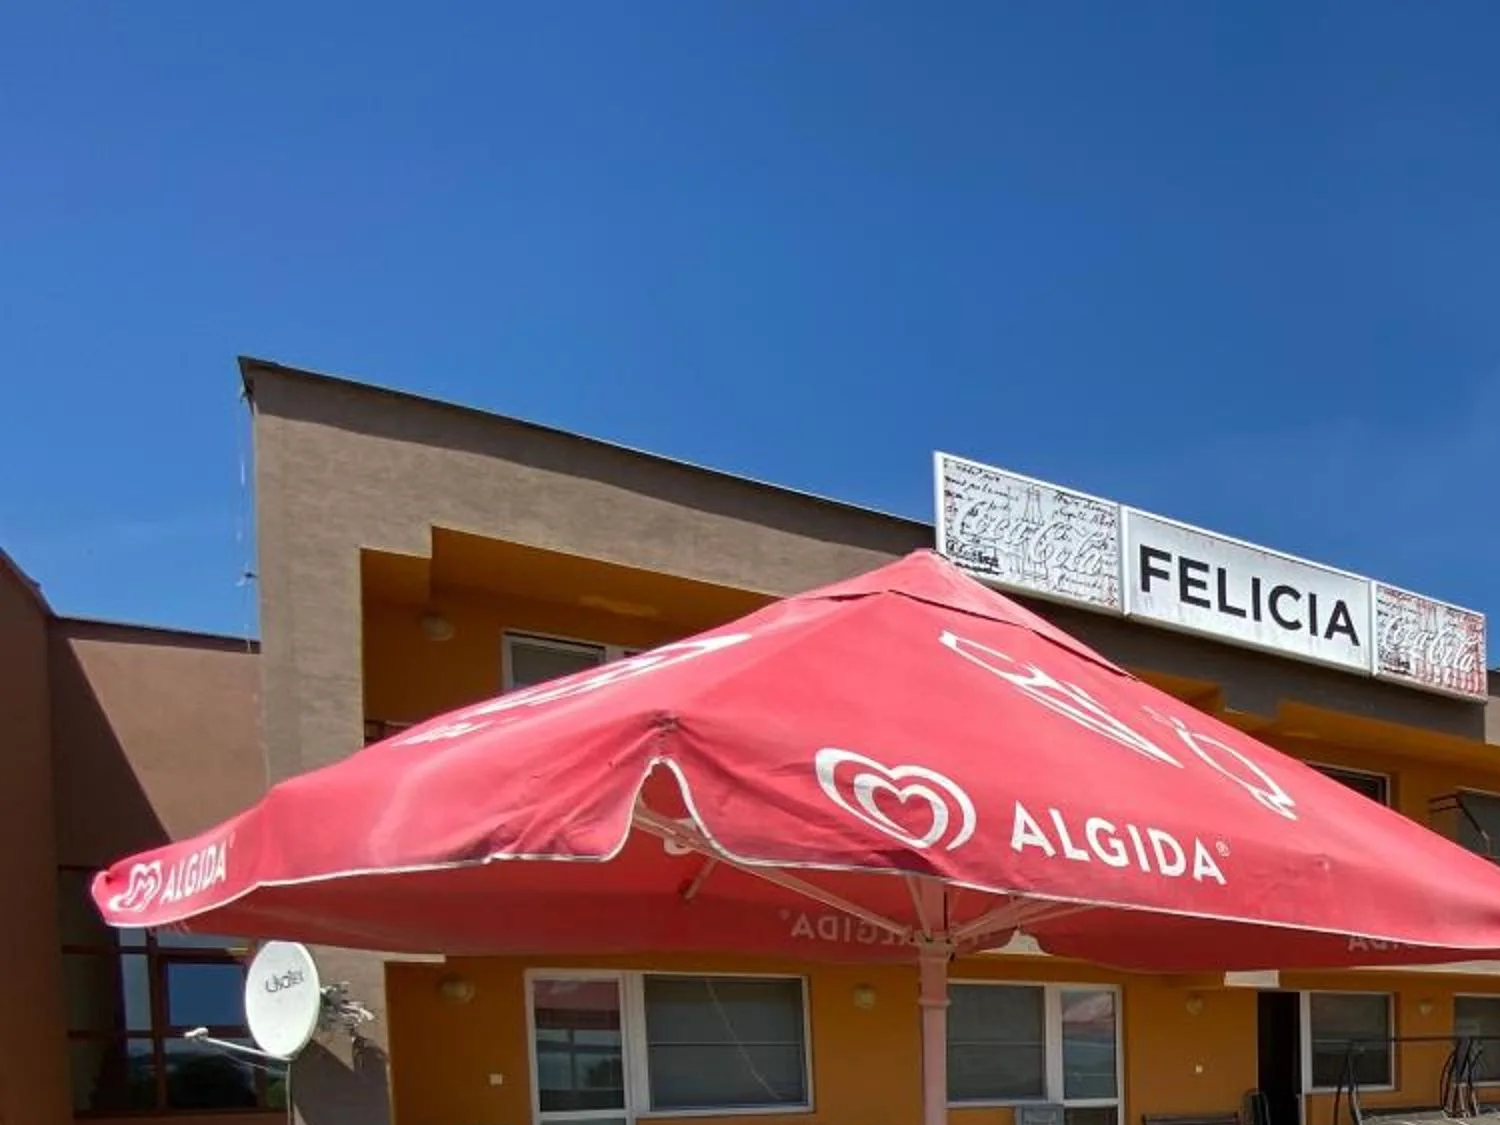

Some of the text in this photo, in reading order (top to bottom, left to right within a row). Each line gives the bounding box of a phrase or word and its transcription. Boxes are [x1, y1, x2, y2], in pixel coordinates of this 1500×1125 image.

[1139, 543, 1361, 647] FELICIA
[159, 840, 228, 905] ALGIDA
[1010, 799, 1228, 885] ALGIDA
